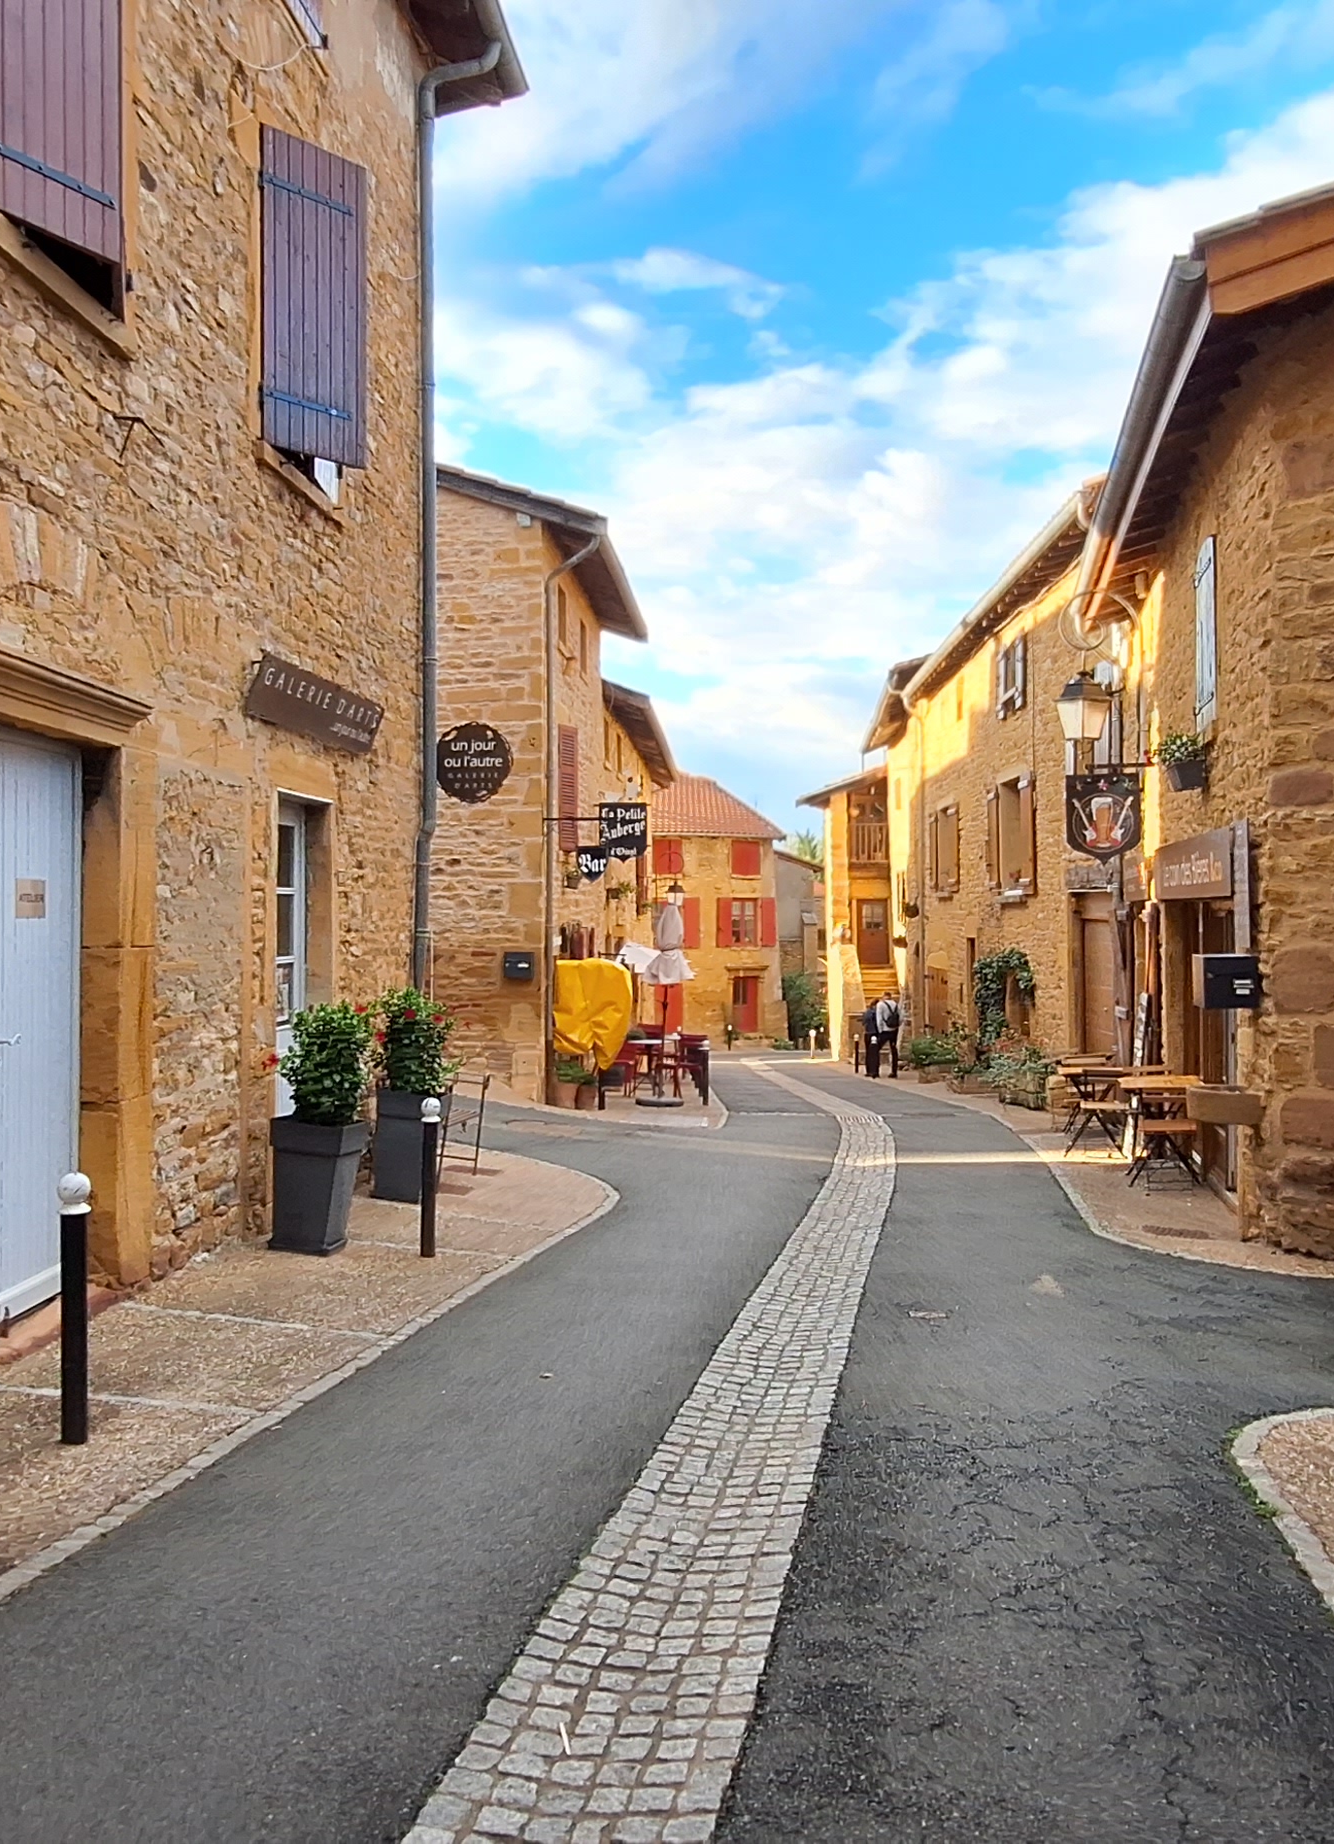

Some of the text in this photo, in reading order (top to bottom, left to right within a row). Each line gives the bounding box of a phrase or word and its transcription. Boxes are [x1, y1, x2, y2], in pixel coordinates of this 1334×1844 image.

[264, 667, 333, 709] GALERIE
[451, 739, 496, 754] un jour
[444, 755, 503, 767] ou l'autre
[601, 808, 646, 821] La Petite
[600, 820, 646, 840] Auberge
[578, 853, 607, 873] Bar
